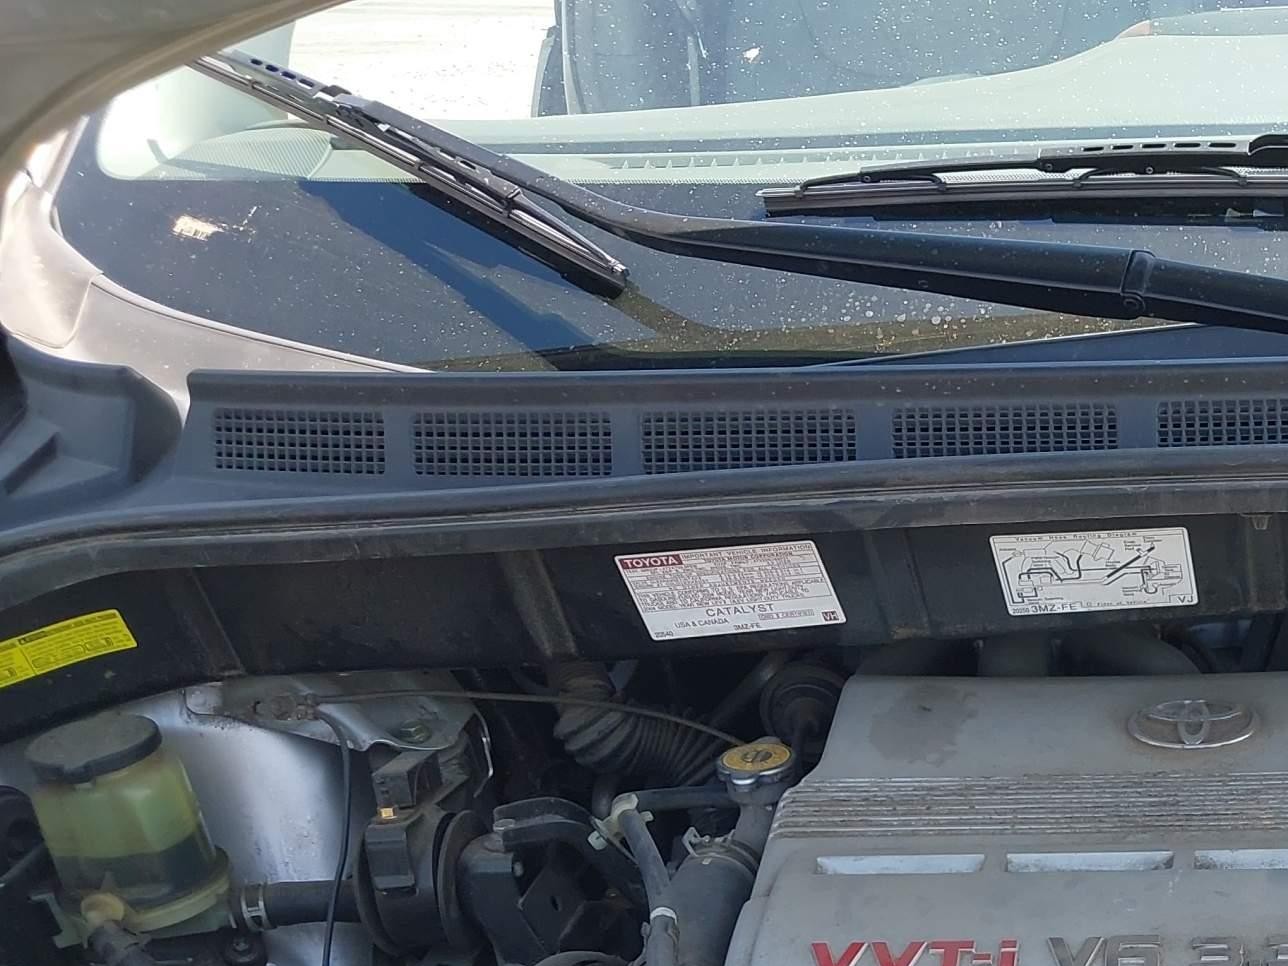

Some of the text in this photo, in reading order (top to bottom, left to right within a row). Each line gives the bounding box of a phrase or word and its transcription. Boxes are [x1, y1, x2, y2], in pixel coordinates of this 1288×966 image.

[682, 543, 812, 561] IMPORTANT VEHICLE INFORMATION
[622, 555, 679, 568] TOYOTA
[1178, 595, 1194, 603] VJ
[705, 603, 774, 617] CATALYST
[1030, 604, 1077, 614] 3MZ-FE
[823, 612, 839, 621] VH
[674, 620, 689, 629] USA
[698, 617, 730, 627] CANADA
[733, 622, 762, 631] 3MZ-FE
